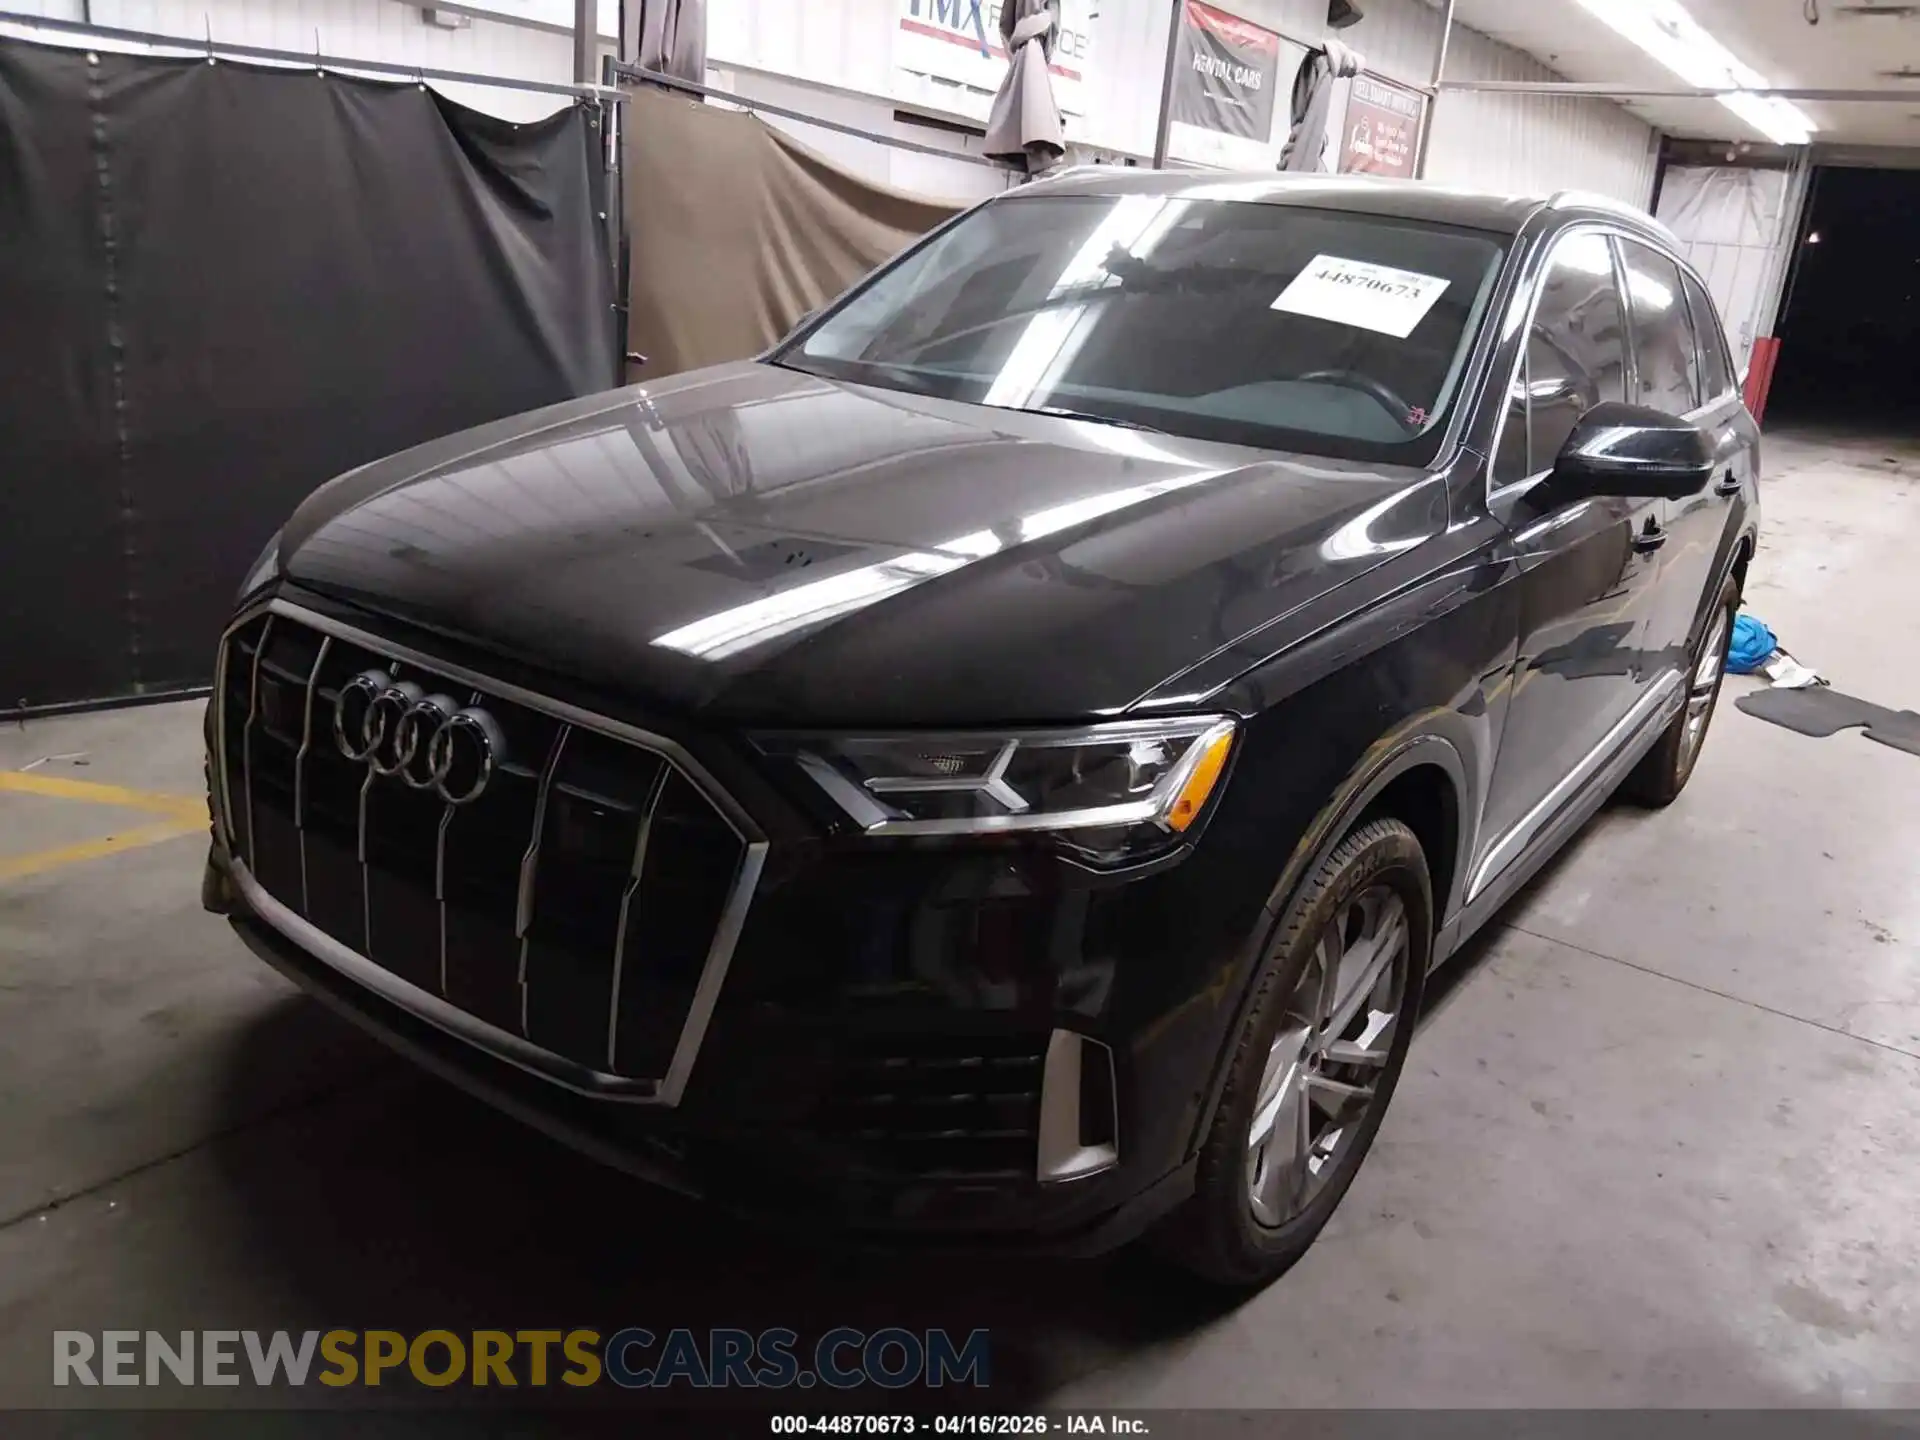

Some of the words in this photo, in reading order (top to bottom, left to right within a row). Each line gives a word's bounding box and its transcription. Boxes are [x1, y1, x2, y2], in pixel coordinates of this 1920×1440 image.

[1193, 51, 1231, 81] RENTAL
[1235, 66, 1262, 90] CARS
[1314, 270, 1421, 299] 44870673
